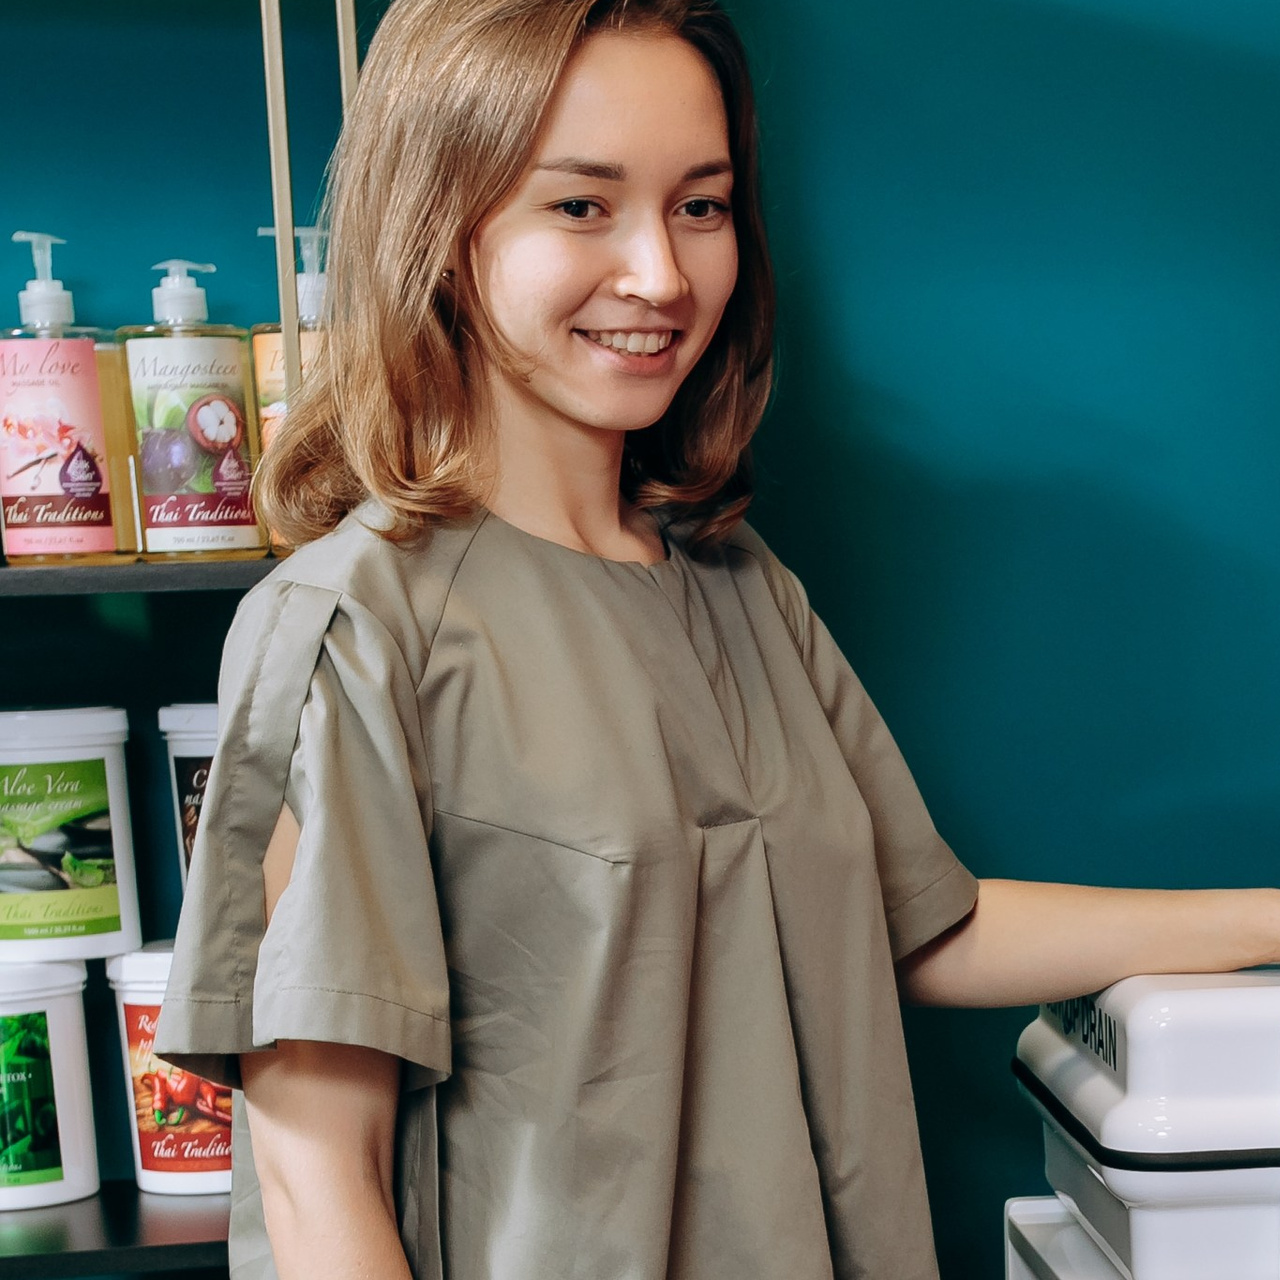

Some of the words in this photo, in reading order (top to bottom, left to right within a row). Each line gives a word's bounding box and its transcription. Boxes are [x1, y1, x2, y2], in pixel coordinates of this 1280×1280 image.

[39, 341, 81, 375] love
[134, 355, 240, 384] Mangosteen
[5, 496, 30, 524] Thai
[33, 498, 105, 524] Traditions
[149, 495, 181, 524] Thai
[184, 497, 254, 522] Traditions
[0, 767, 36, 797] Aloe
[44, 771, 82, 795] Vera
[0, 801, 43, 822] assage
[151, 1133, 178, 1158] Thai
[181, 1133, 232, 1158] Traditio
